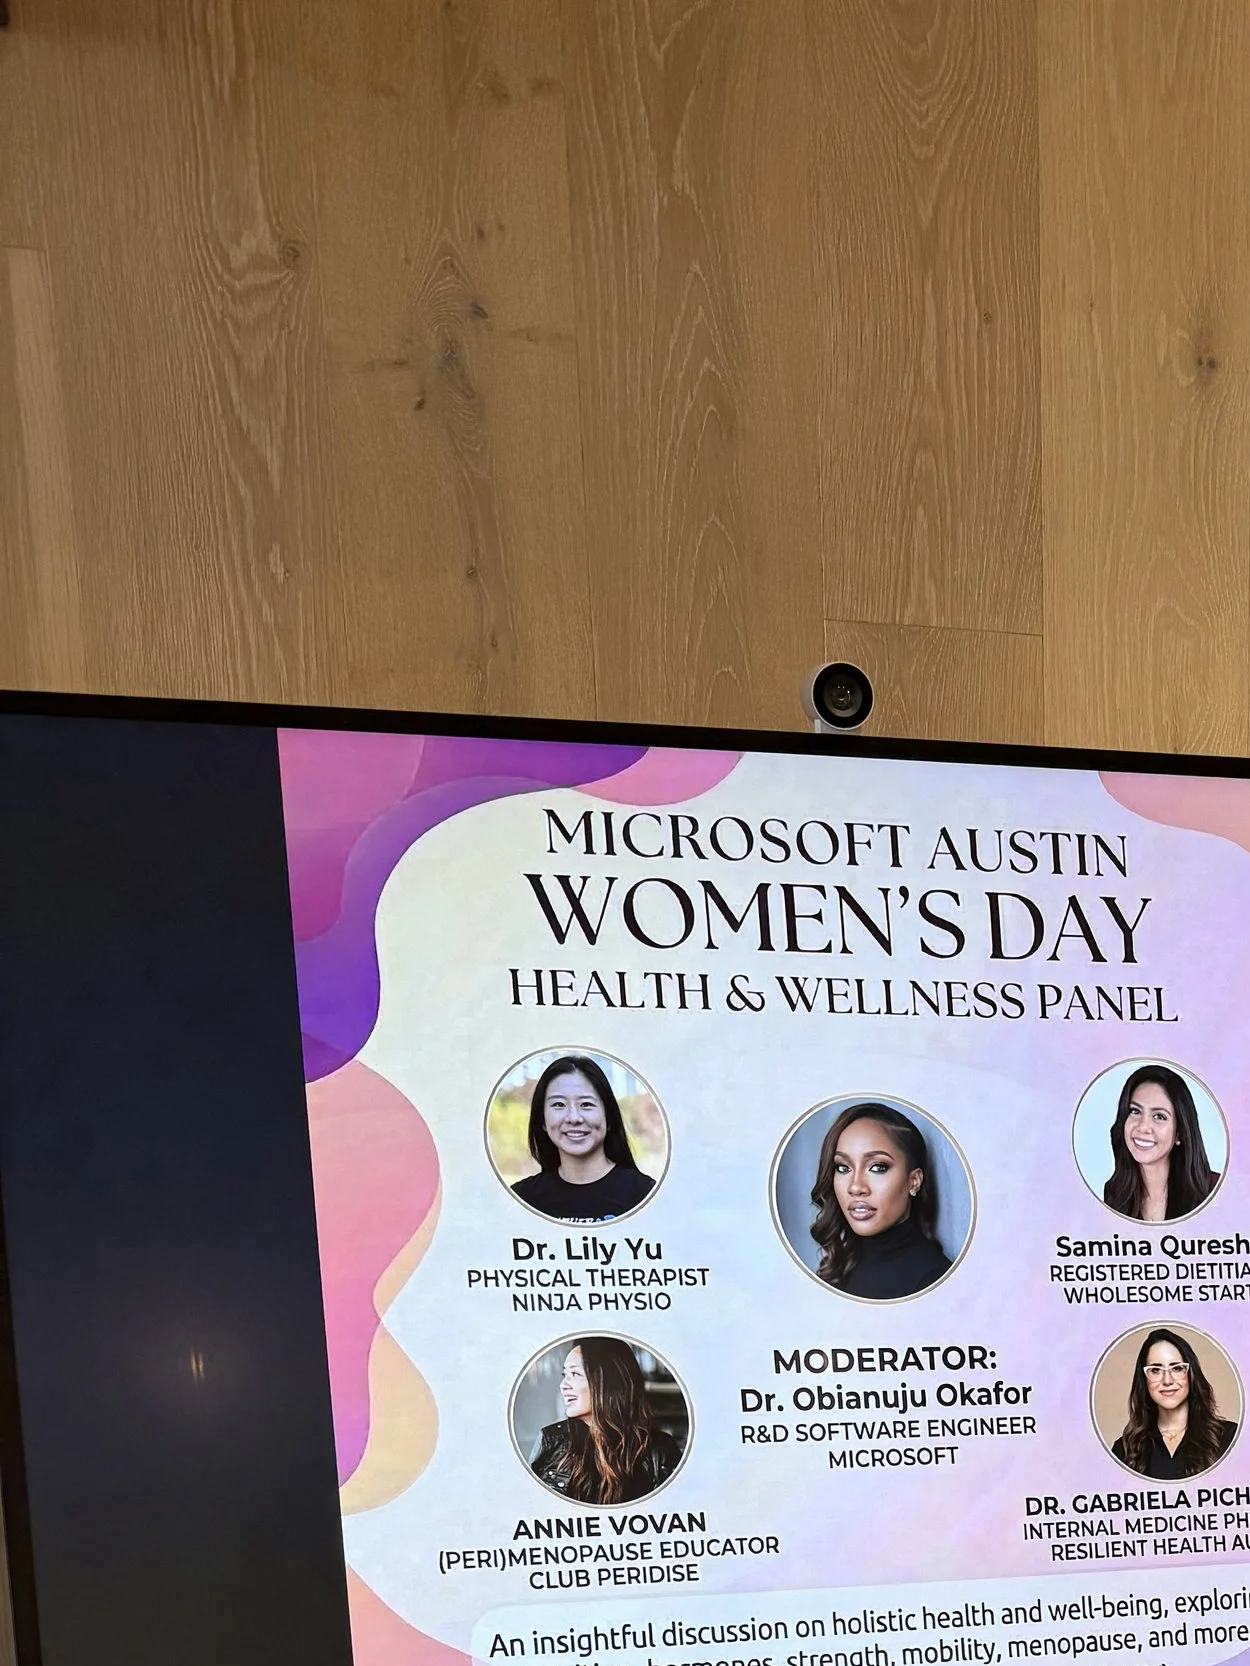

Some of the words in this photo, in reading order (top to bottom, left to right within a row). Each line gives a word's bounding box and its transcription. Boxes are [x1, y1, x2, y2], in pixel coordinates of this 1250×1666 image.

[542, 808, 911, 868] MICROSOFT
[927, 826, 1127, 878] AUSTIN
[984, 891, 1152, 964] DAY
[508, 968, 712, 1010] HEALTH
[725, 974, 766, 1012] &
[774, 976, 1025, 1020] WELLNESS
[1037, 983, 1179, 1022] PANEL
[512, 1237, 556, 1261] Dr.
[565, 1235, 617, 1266] Lily
[624, 1237, 663, 1260] Yu
[1056, 1233, 1152, 1258] Samina
[467, 1268, 581, 1288] PHYSICAL
[585, 1268, 710, 1287] THERAPIST
[1050, 1263, 1170, 1282] REGISTERED
[512, 1293, 583, 1312] NINJA
[588, 1291, 671, 1311] PHYSIO
[1063, 1285, 1194, 1304] WHOLESOME
[773, 1345, 997, 1374] MODERATOR:
[740, 1388, 784, 1413] Dr.
[792, 1382, 927, 1415] Obianuju
[936, 1380, 1032, 1407] Okafor
[741, 1424, 789, 1444] R&D
[795, 1419, 921, 1442] SOFTWARE
[927, 1416, 1037, 1438] ENGINEER
[828, 1446, 959, 1469] MICROSOFT
[1025, 1496, 1066, 1517] DR.
[1072, 1489, 1192, 1514] GABRIELA
[512, 1516, 602, 1541] ANNIE
[607, 1511, 706, 1536] VOVAN
[1023, 1519, 1121, 1541] INTERNAL
[1125, 1513, 1219, 1535] MEDICINE
[439, 1541, 653, 1575] (PERI)MENOPAUSE
[659, 1536, 780, 1559] EDUCATOR
[1051, 1539, 1148, 1562] RESILIENT
[1153, 1534, 1227, 1556] HEALTH
[529, 1569, 591, 1590] CLUB
[597, 1563, 700, 1587] PERIDISE
[489, 1633, 525, 1658] An
[532, 1622, 656, 1658] insightful
[662, 1617, 789, 1647] discussion
[795, 1619, 826, 1638] on
[832, 1608, 917, 1636] holistic
[922, 1601, 995, 1630] health
[1001, 1598, 1042, 1625] and
[1047, 1593, 1169, 1622] well-being,
[902, 1637, 1002, 1666] mobility,
[1008, 1632, 1143, 1659] menopause,
[1148, 1622, 1188, 1648] and
